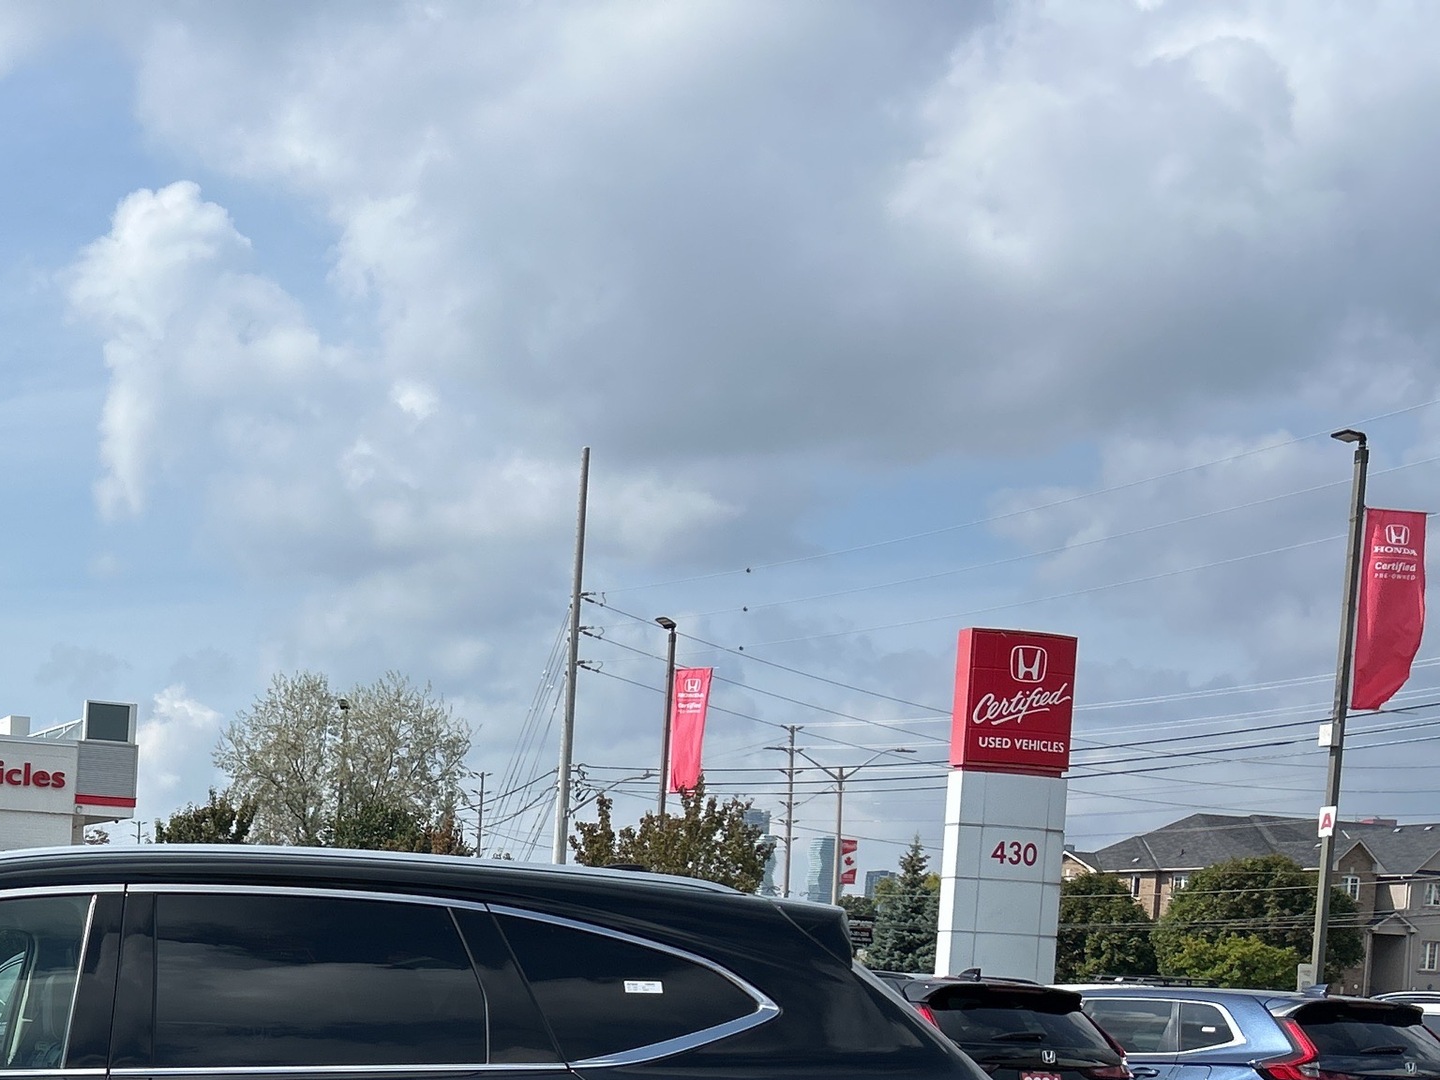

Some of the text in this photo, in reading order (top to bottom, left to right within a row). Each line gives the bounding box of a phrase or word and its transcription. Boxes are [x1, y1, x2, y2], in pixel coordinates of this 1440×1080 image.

[1373, 545, 1418, 556] HONDA
[1374, 561, 1416, 572] Certified
[1373, 572, 1416, 580] PRE-OWNED
[972, 682, 1072, 726] Certified
[978, 736, 1065, 753] USED VEHICLES
[1320, 812, 1332, 830] A
[991, 841, 1038, 866] 430
